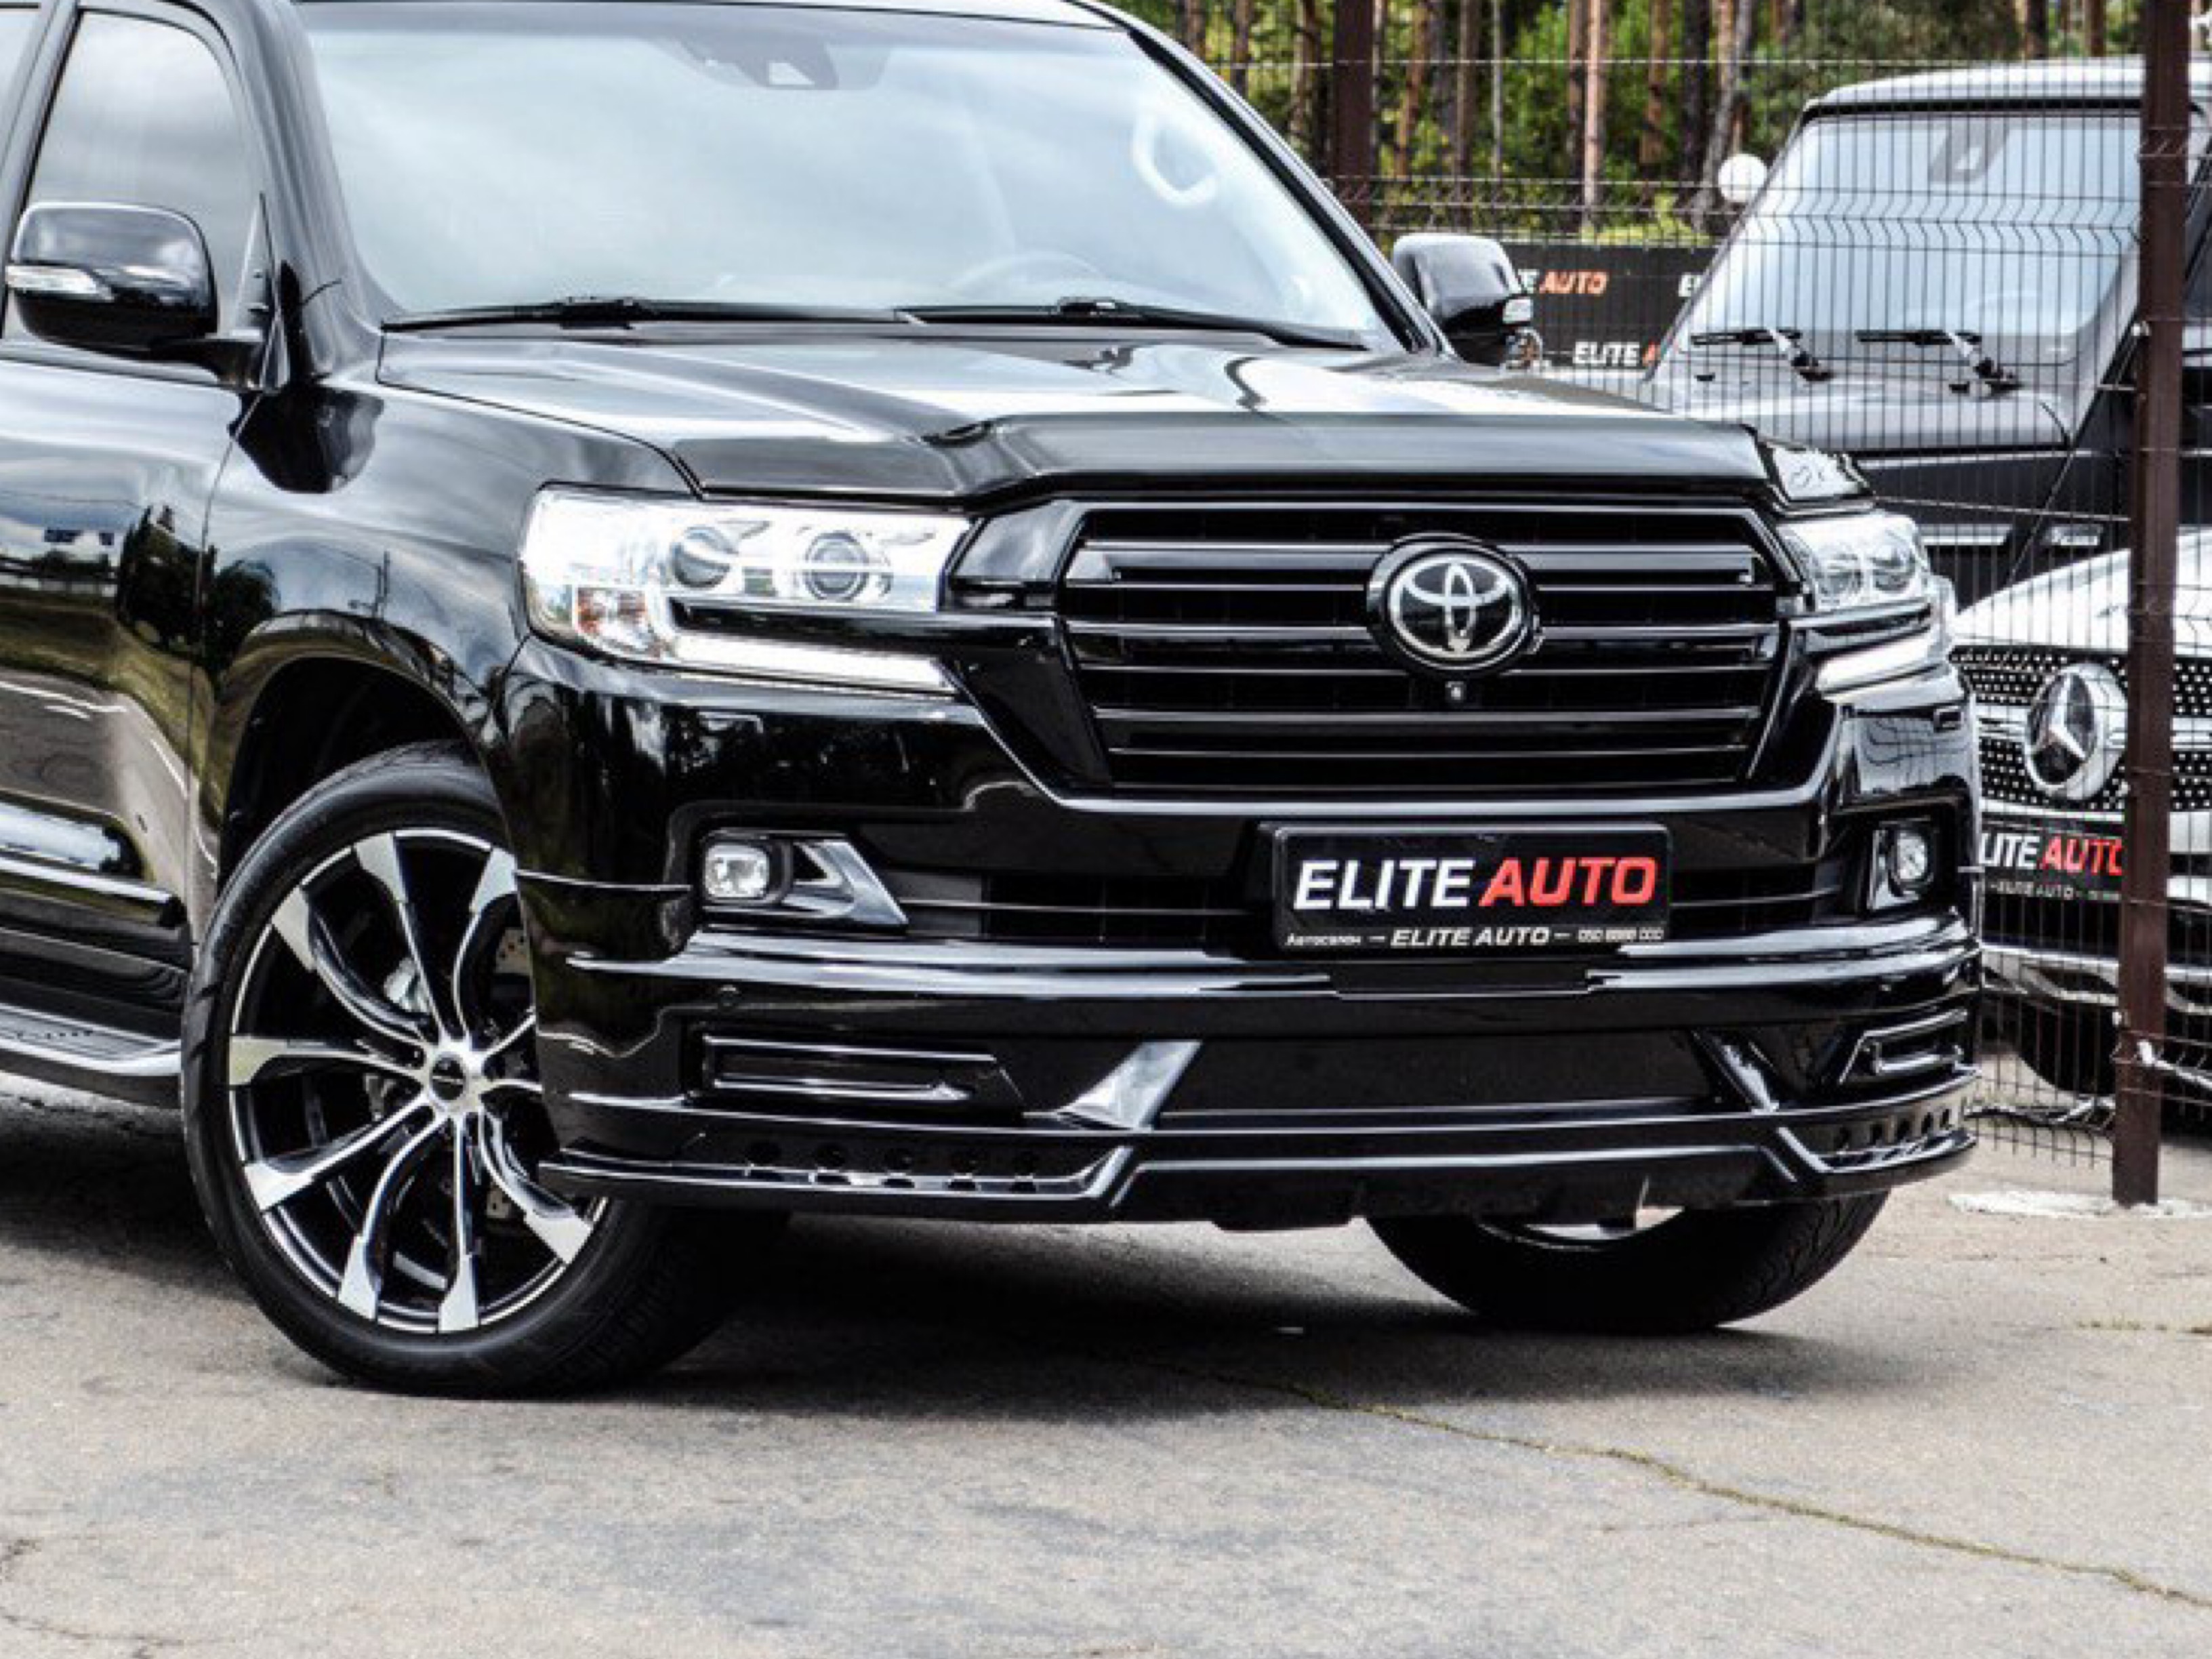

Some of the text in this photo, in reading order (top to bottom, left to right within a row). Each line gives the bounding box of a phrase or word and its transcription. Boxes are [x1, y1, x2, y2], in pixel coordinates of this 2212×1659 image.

[1539, 270, 1608, 294] AUTO
[1573, 342, 1639, 367] ELITE
[1979, 832, 2040, 867] LITE
[1293, 857, 1657, 910] ELITE AUTO
[1391, 926, 1472, 947] ELITE
[1473, 926, 1550, 946] AUTO
